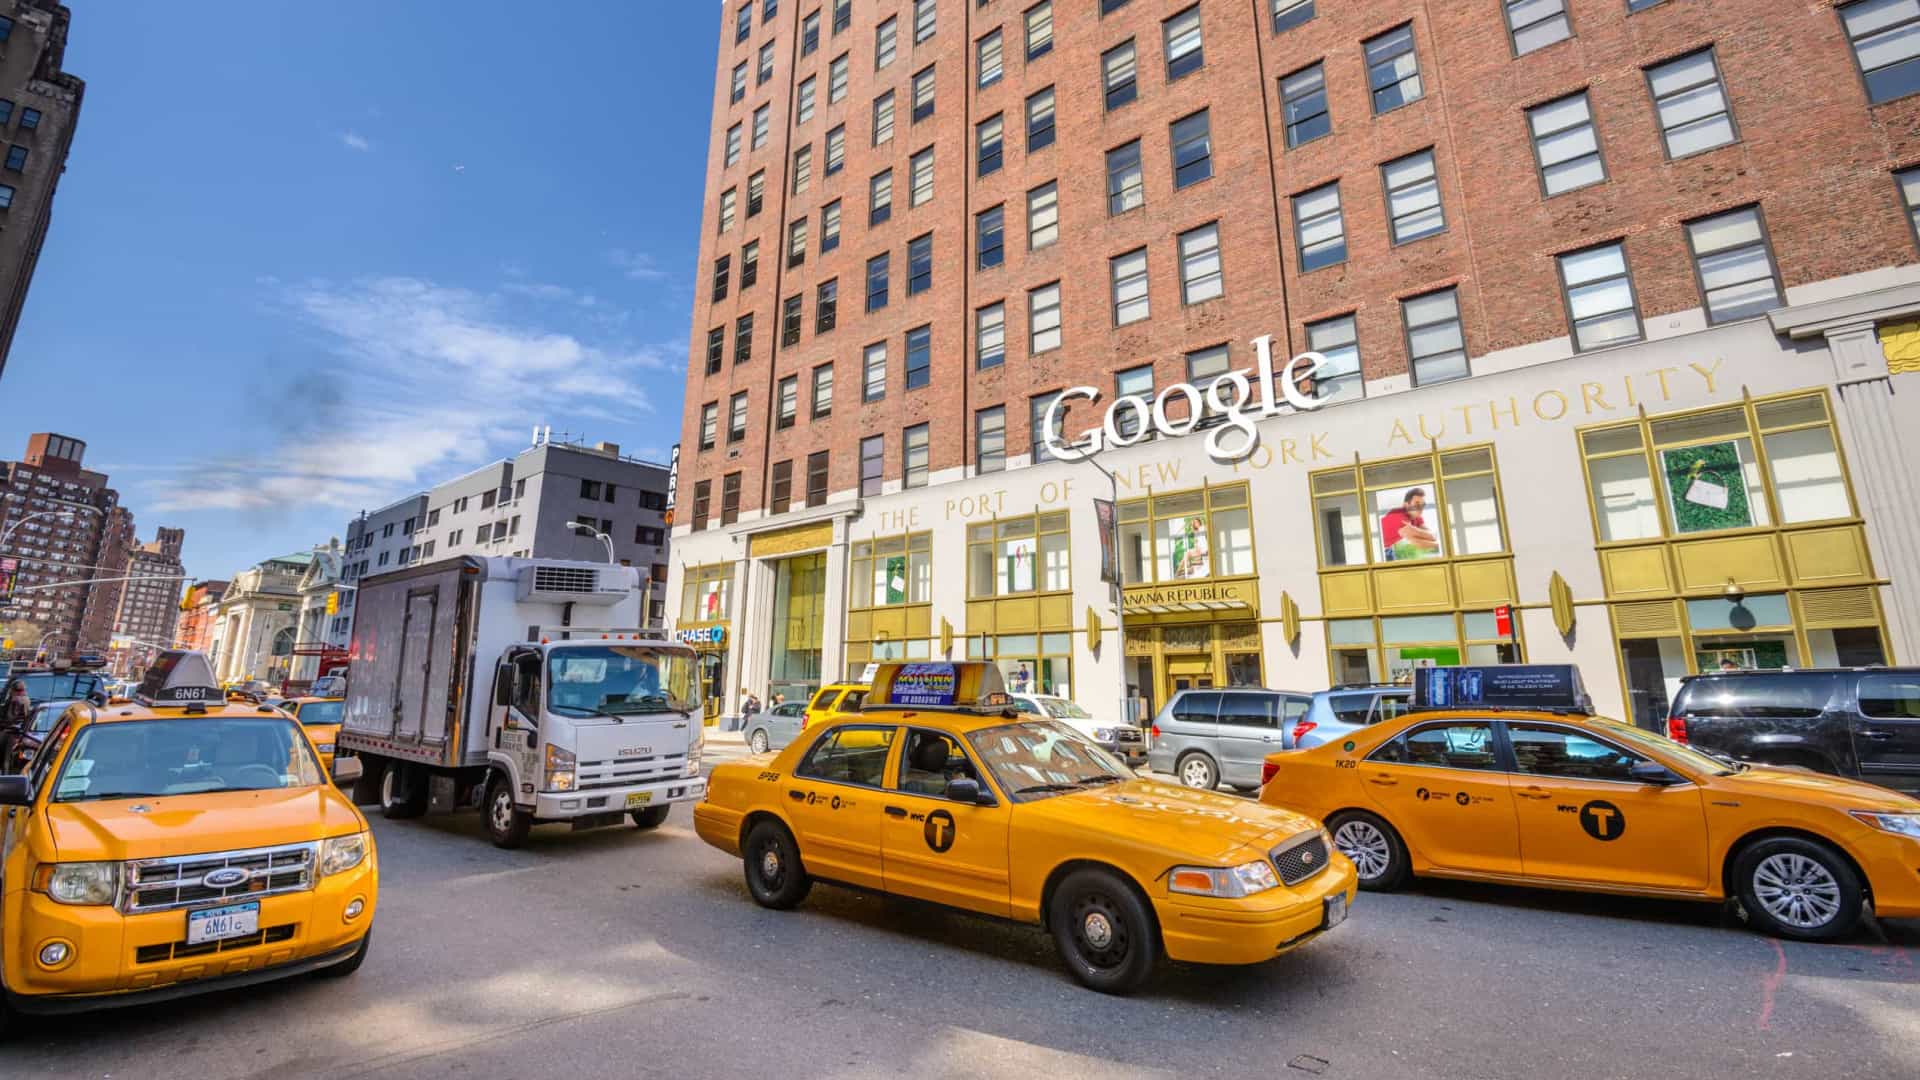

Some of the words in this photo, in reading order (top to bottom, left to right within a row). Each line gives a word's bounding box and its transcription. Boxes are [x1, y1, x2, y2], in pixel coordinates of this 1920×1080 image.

[1042, 334, 1329, 461] Google
[880, 505, 920, 530] THE
[945, 489, 1008, 521] PORT
[1040, 478, 1075, 503] OF
[1114, 458, 1182, 490] NEW
[1387, 357, 1724, 447] AUTHORITY
[667, 447, 680, 505] PARK
[1122, 591, 1165, 606] ANANA
[1166, 586, 1238, 602] REPUBLIC
[675, 629, 711, 642] CHASE
[175, 688, 207, 700] 6N61
[1556, 804, 1578, 814] NYC
